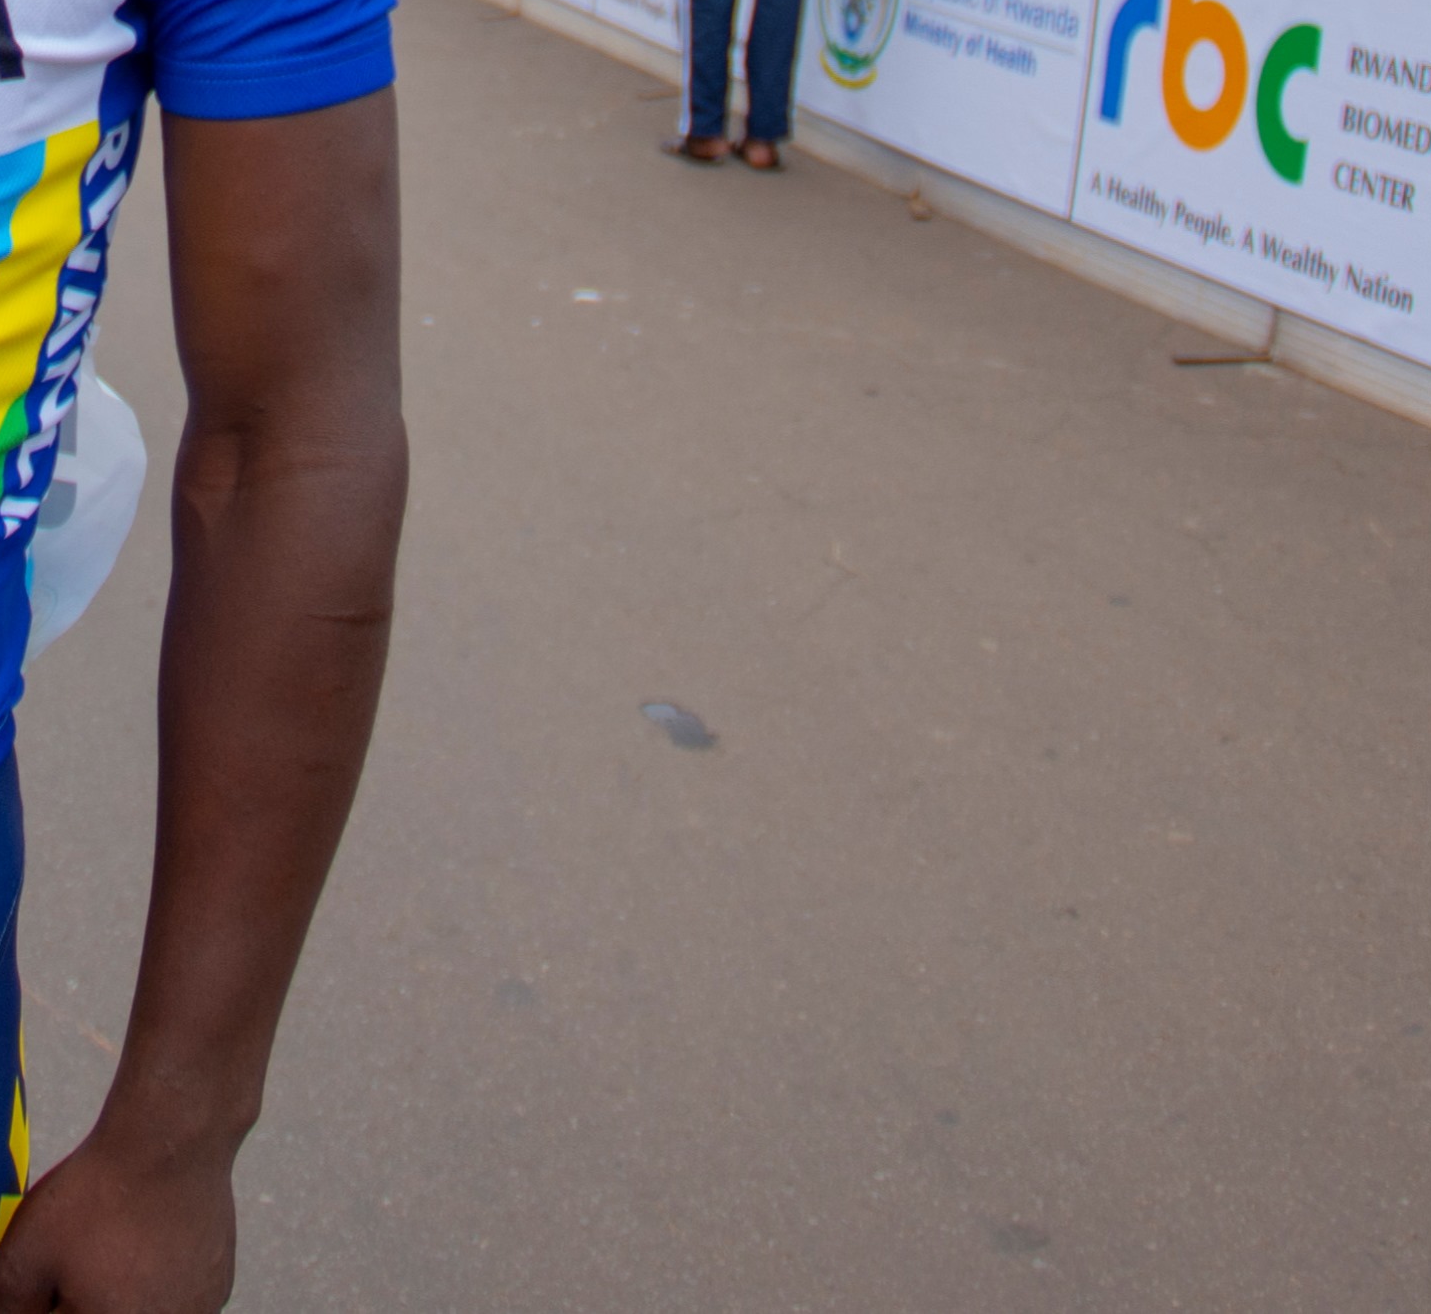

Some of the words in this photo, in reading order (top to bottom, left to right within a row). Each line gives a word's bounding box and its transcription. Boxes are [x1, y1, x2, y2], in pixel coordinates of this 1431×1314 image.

[903, 9, 963, 58] Ministry
[965, 31, 984, 57] of
[985, 36, 1039, 78] Health
[1333, 160, 1417, 215] CENTER
[1090, 169, 1104, 196] A
[1107, 176, 1171, 228] Healthy
[1174, 198, 1236, 248] People.
[1242, 227, 1255, 255] A
[1261, 231, 1340, 295] Wealthy
[1345, 262, 1415, 316] Nation
